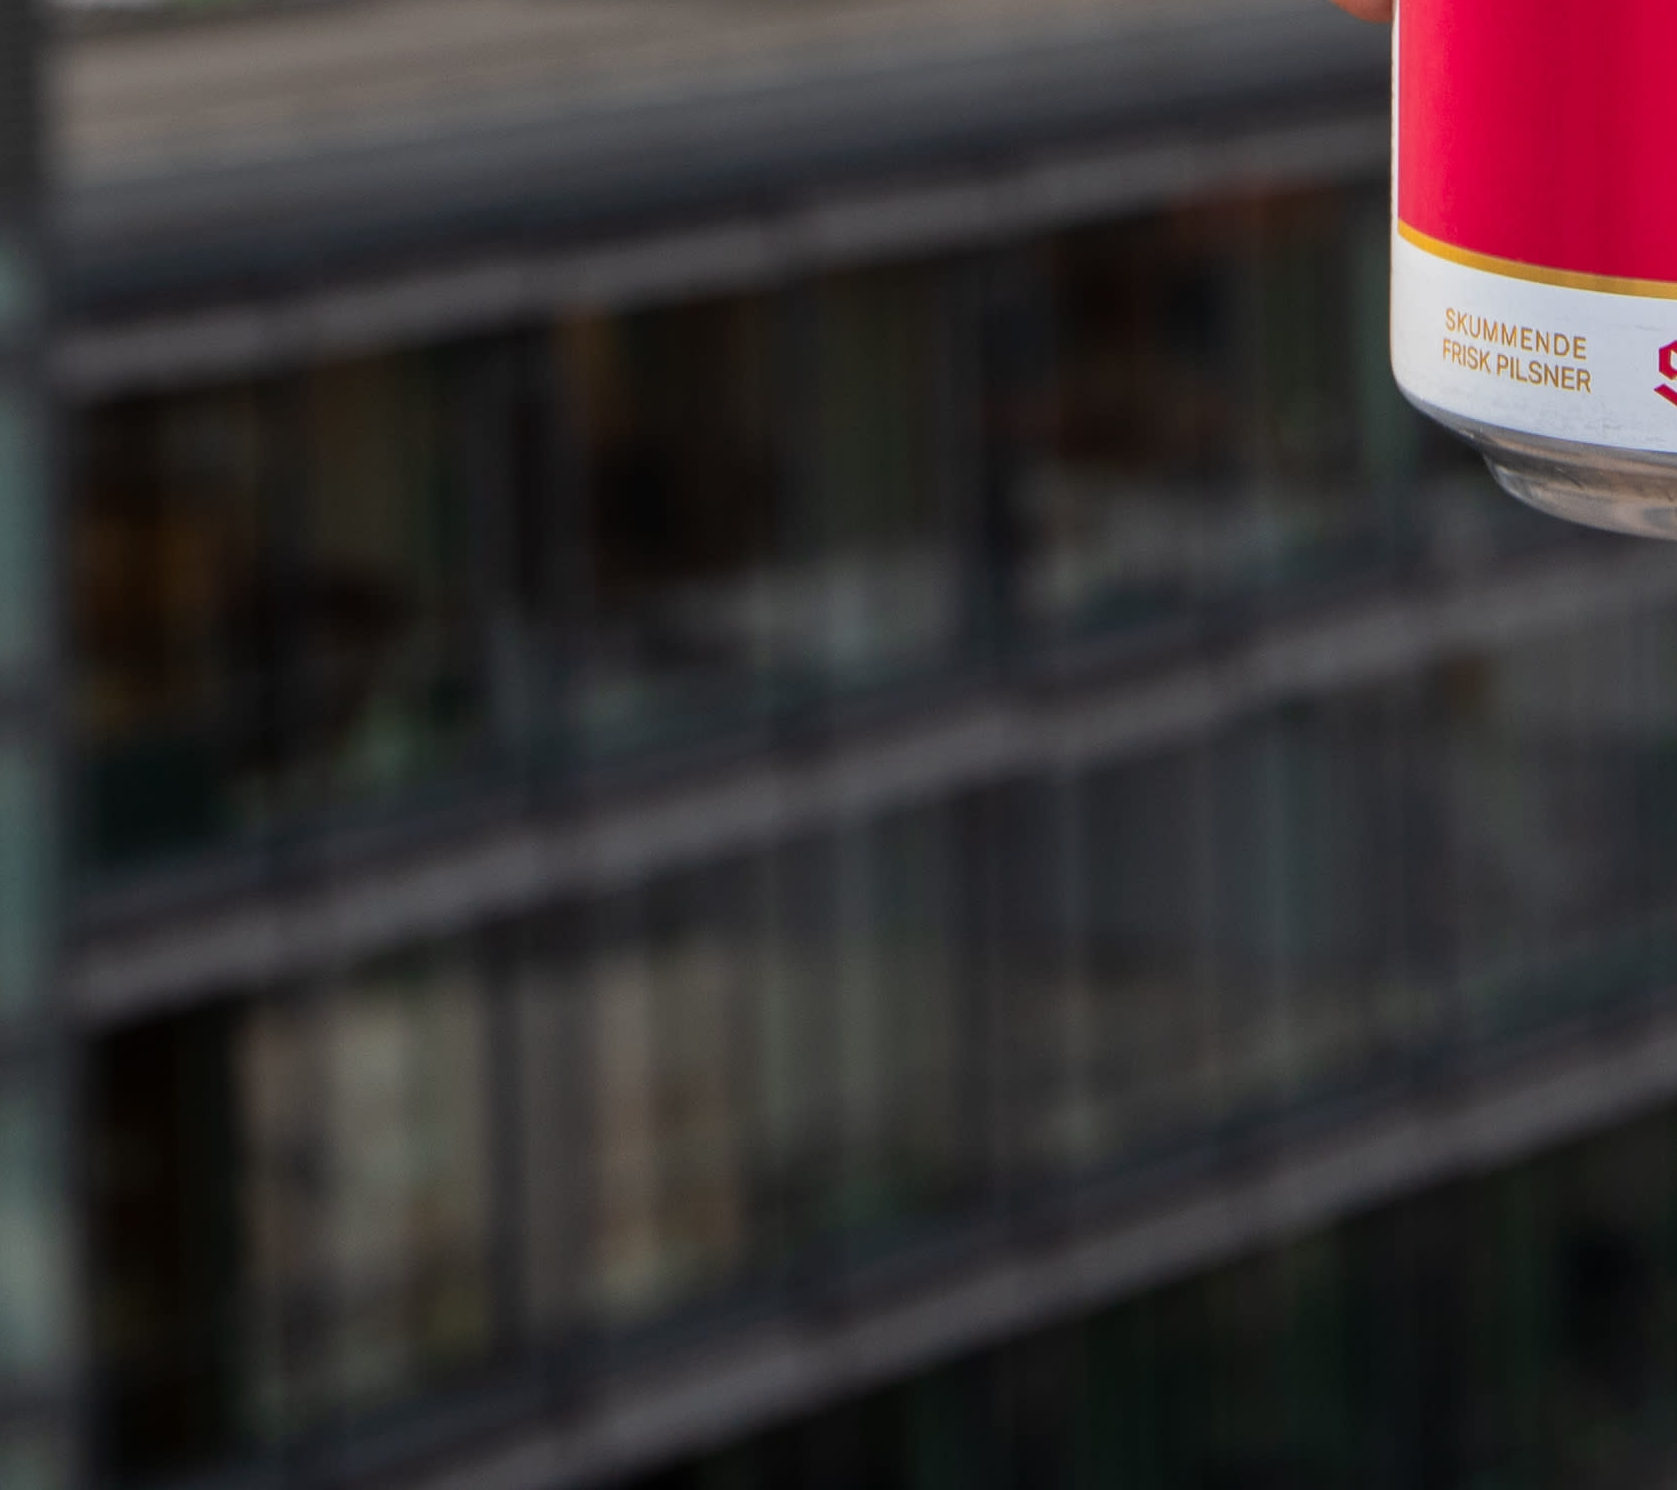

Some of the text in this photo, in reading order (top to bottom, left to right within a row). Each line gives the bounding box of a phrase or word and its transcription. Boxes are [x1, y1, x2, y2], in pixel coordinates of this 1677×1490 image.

[1445, 306, 1588, 361] SKUMMENDE
[1442, 336, 1592, 394] FRISK PILSNER
